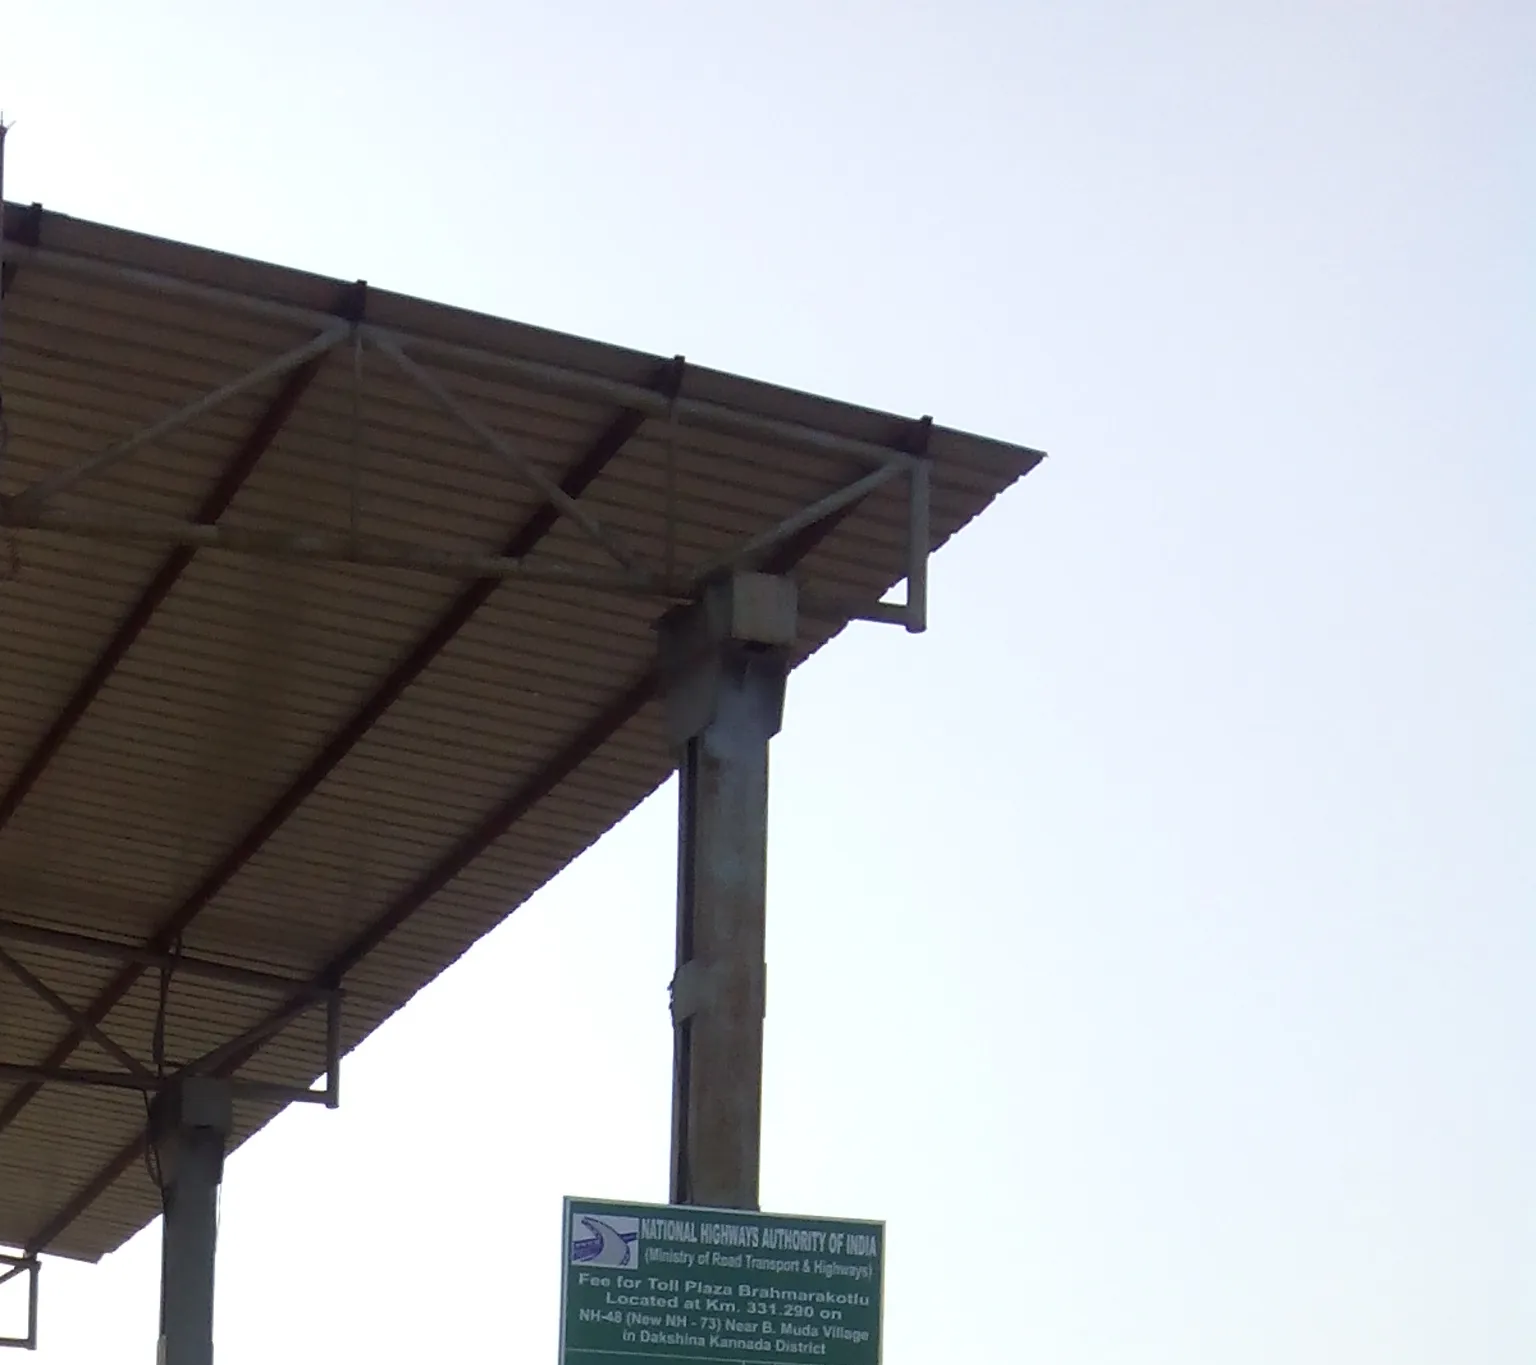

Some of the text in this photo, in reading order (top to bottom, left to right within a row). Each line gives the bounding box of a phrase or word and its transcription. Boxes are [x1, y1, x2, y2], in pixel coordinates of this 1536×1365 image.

[641, 1219, 876, 1256] NATIONAL HIGHWAYS AUTHORITY OF INDIA
[645, 1247, 873, 1281] (Ministry of Road Transport & Highways)
[578, 1273, 870, 1306] Fee for Toll Plaza Brahmarakotlu
[606, 1292, 842, 1320] Located at Km. 331.290 on
[579, 1309, 622, 1324] NH-48
[627, 1314, 663, 1329] (New
[666, 1315, 687, 1328] NH
[701, 1317, 721, 1332] 73)
[725, 1319, 758, 1332] Near
[762, 1321, 775, 1333] B.
[781, 1323, 819, 1337] Muda
[822, 1325, 869, 1343] Village
[623, 1330, 826, 1355] in Dakshina Kannada District
